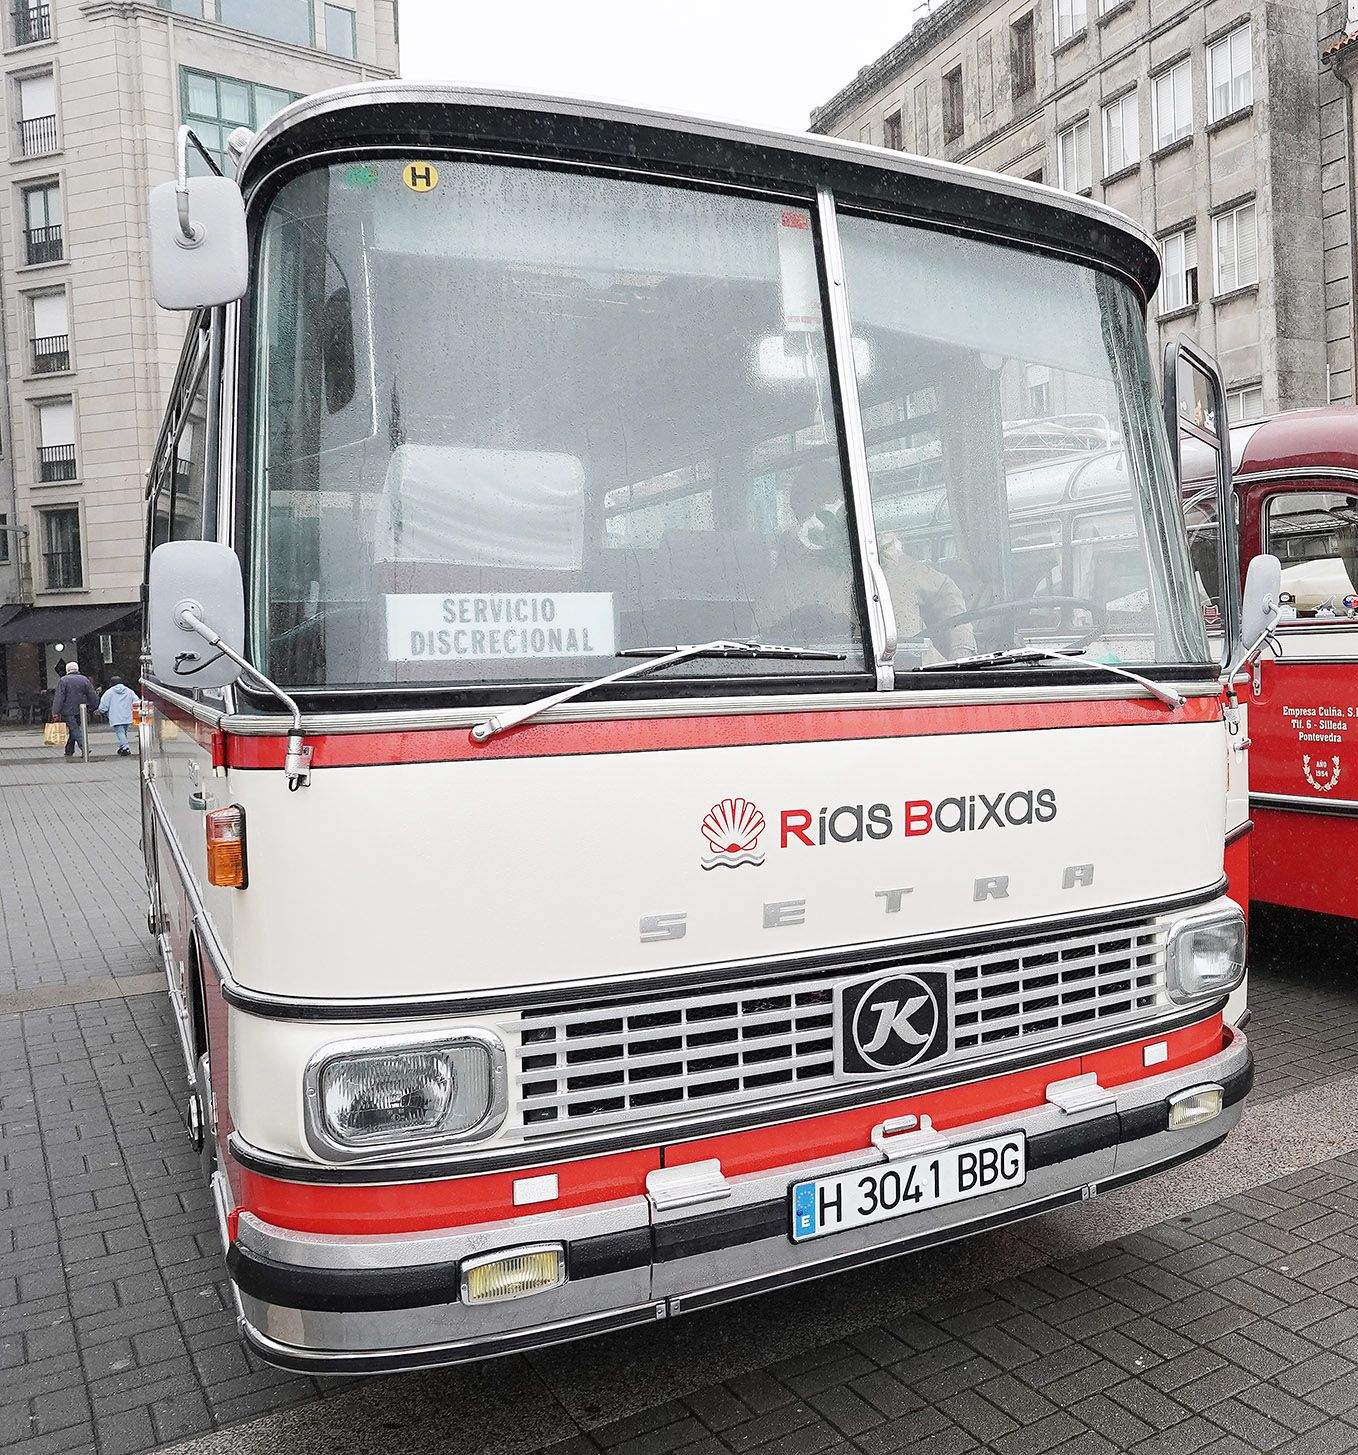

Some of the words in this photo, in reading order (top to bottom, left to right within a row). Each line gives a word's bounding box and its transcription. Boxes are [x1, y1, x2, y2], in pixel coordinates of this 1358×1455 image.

[410, 166, 431, 187] H
[442, 597, 556, 624] SERVICIO
[410, 627, 594, 656] DISCRECIONAL
[1282, 705, 1317, 718] Empresa
[1298, 731, 1342, 742] Pontevedra
[1306, 720, 1312, 729] 6
[1319, 720, 1348, 731] Silleda
[780, 804, 893, 848] Rías
[905, 788, 1058, 837] Baixas
[639, 863, 1095, 943] SETRA
[819, 1183, 842, 1227] H
[857, 1159, 941, 1217] 3041
[958, 1142, 1020, 1193] BBG
[801, 1215, 811, 1228] E
